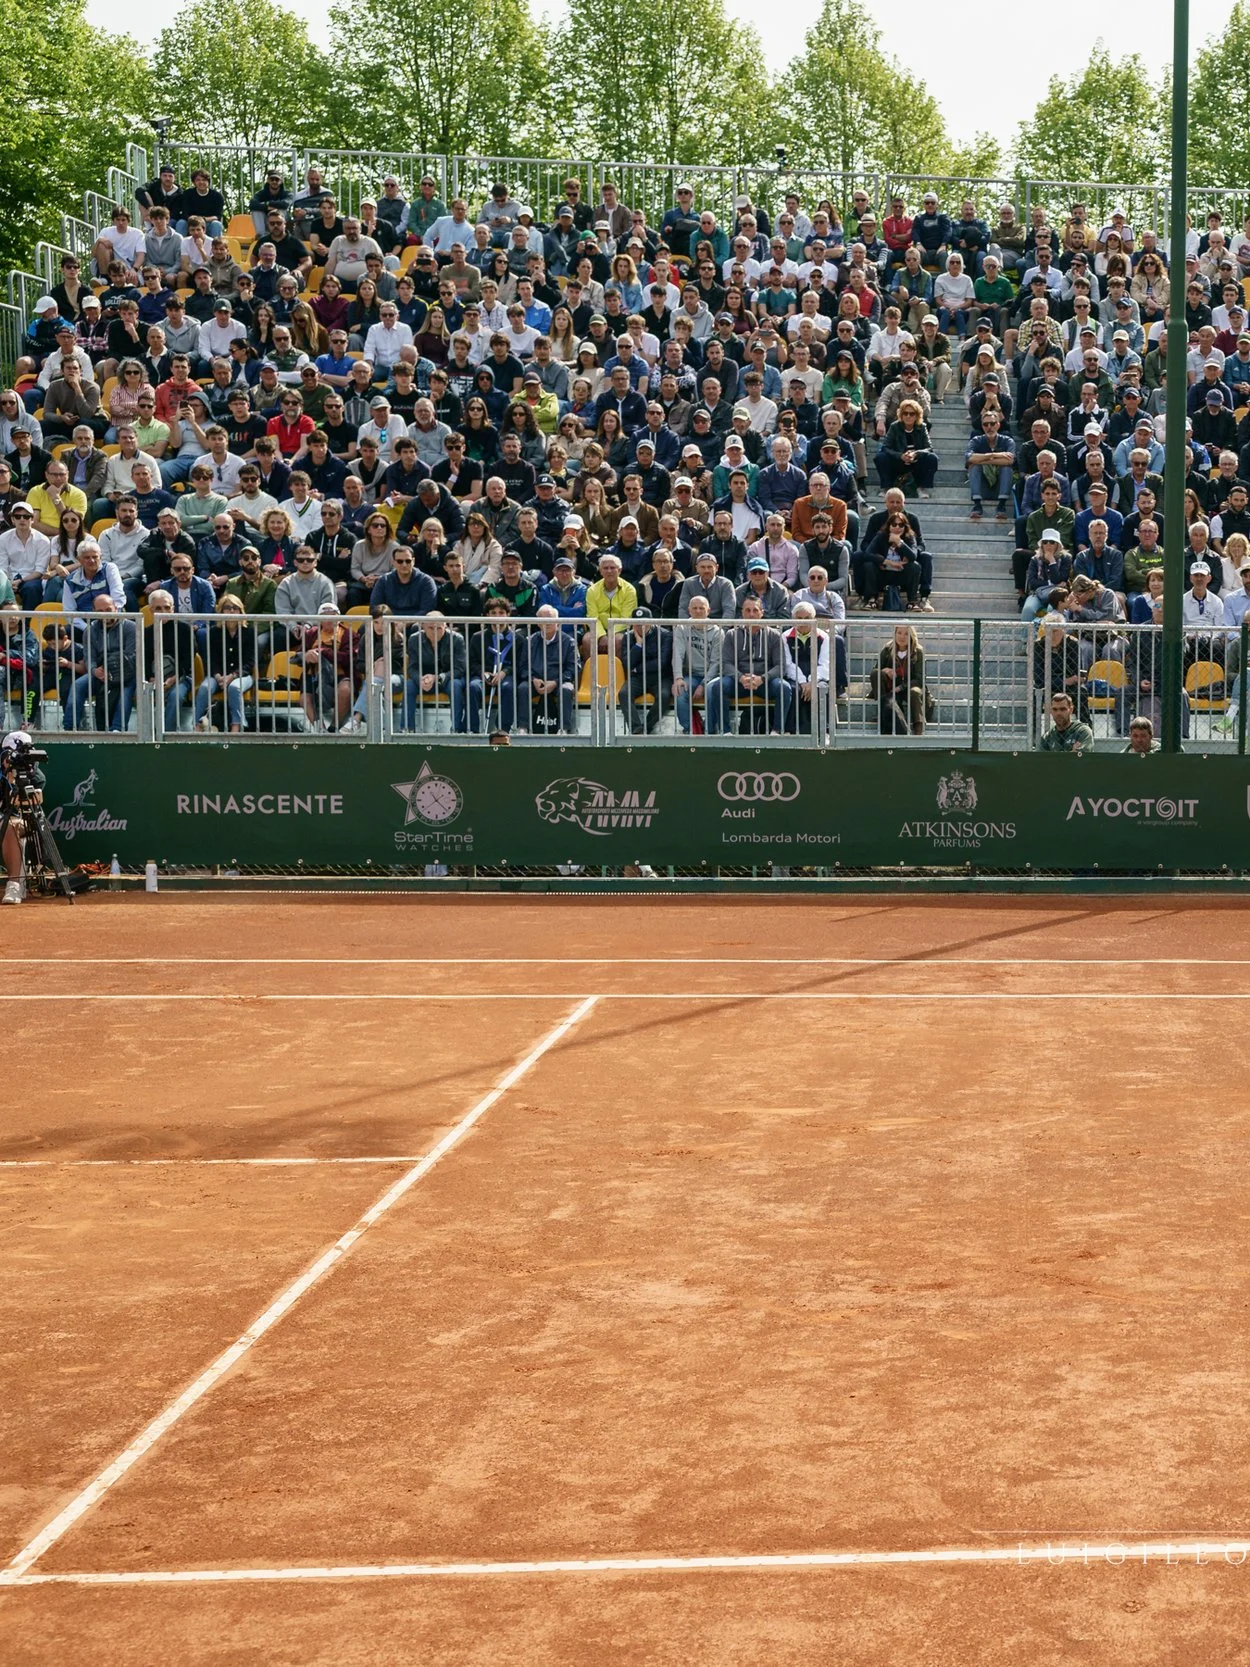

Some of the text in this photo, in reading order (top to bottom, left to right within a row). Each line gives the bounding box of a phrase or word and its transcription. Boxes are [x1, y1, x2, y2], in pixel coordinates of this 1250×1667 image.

[177, 795, 344, 814] RINASCENTE
[721, 808, 755, 818] Audi
[46, 806, 128, 840] Australian
[898, 822, 1017, 838] ATKINSONS
[394, 831, 474, 843] StarTime
[722, 832, 841, 844] Lombarda Motori
[395, 844, 473, 852] WATCHES
[933, 839, 981, 848] PARFUMS
